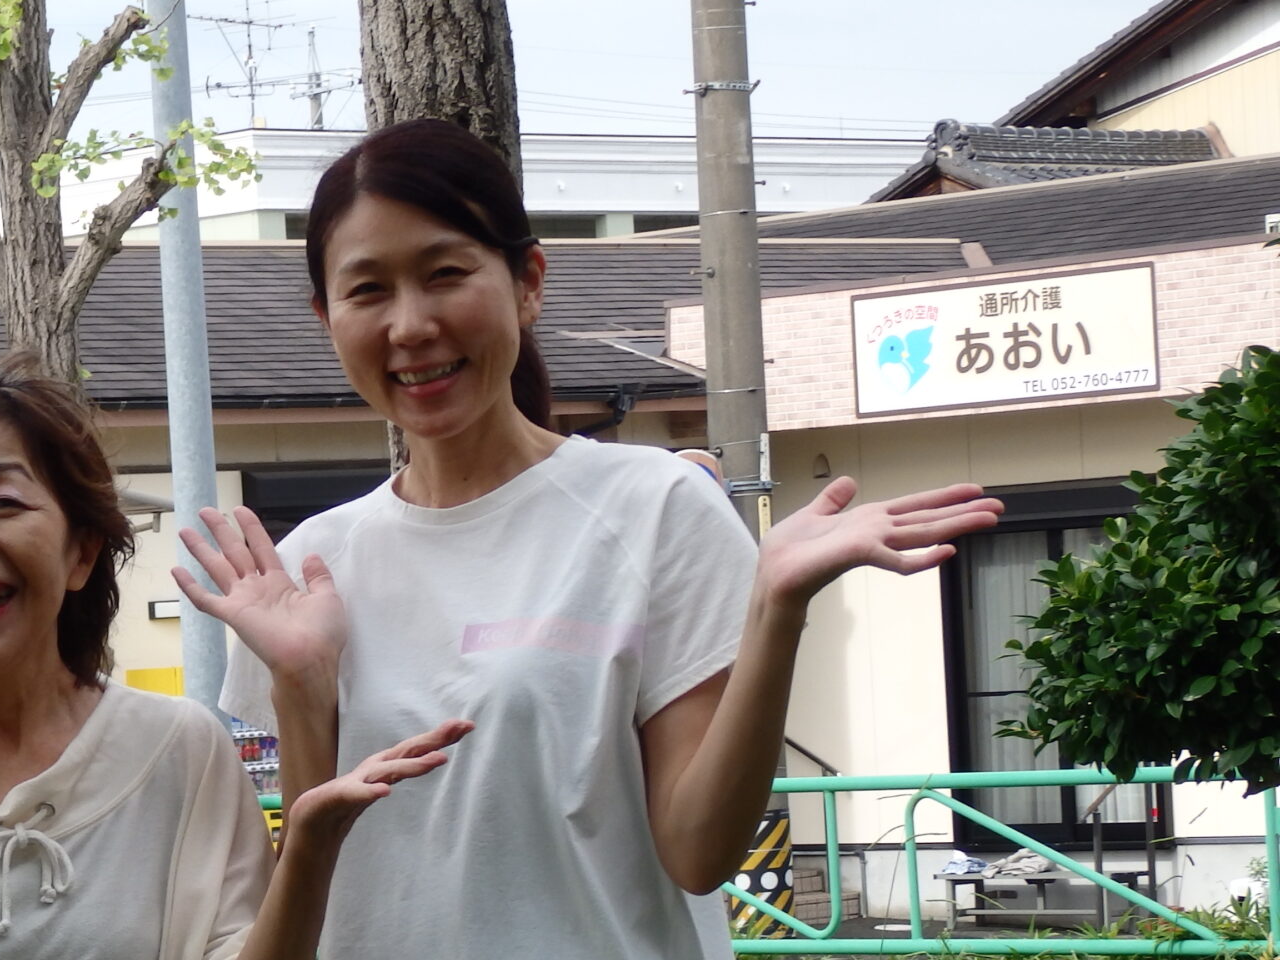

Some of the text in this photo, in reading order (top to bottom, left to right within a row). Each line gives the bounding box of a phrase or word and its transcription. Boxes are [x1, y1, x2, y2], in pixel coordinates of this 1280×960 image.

[978, 286, 1063, 318] 通所介護
[955, 321, 1092, 375] あおい
[1023, 368, 1150, 393] TEL 052-760-4777
